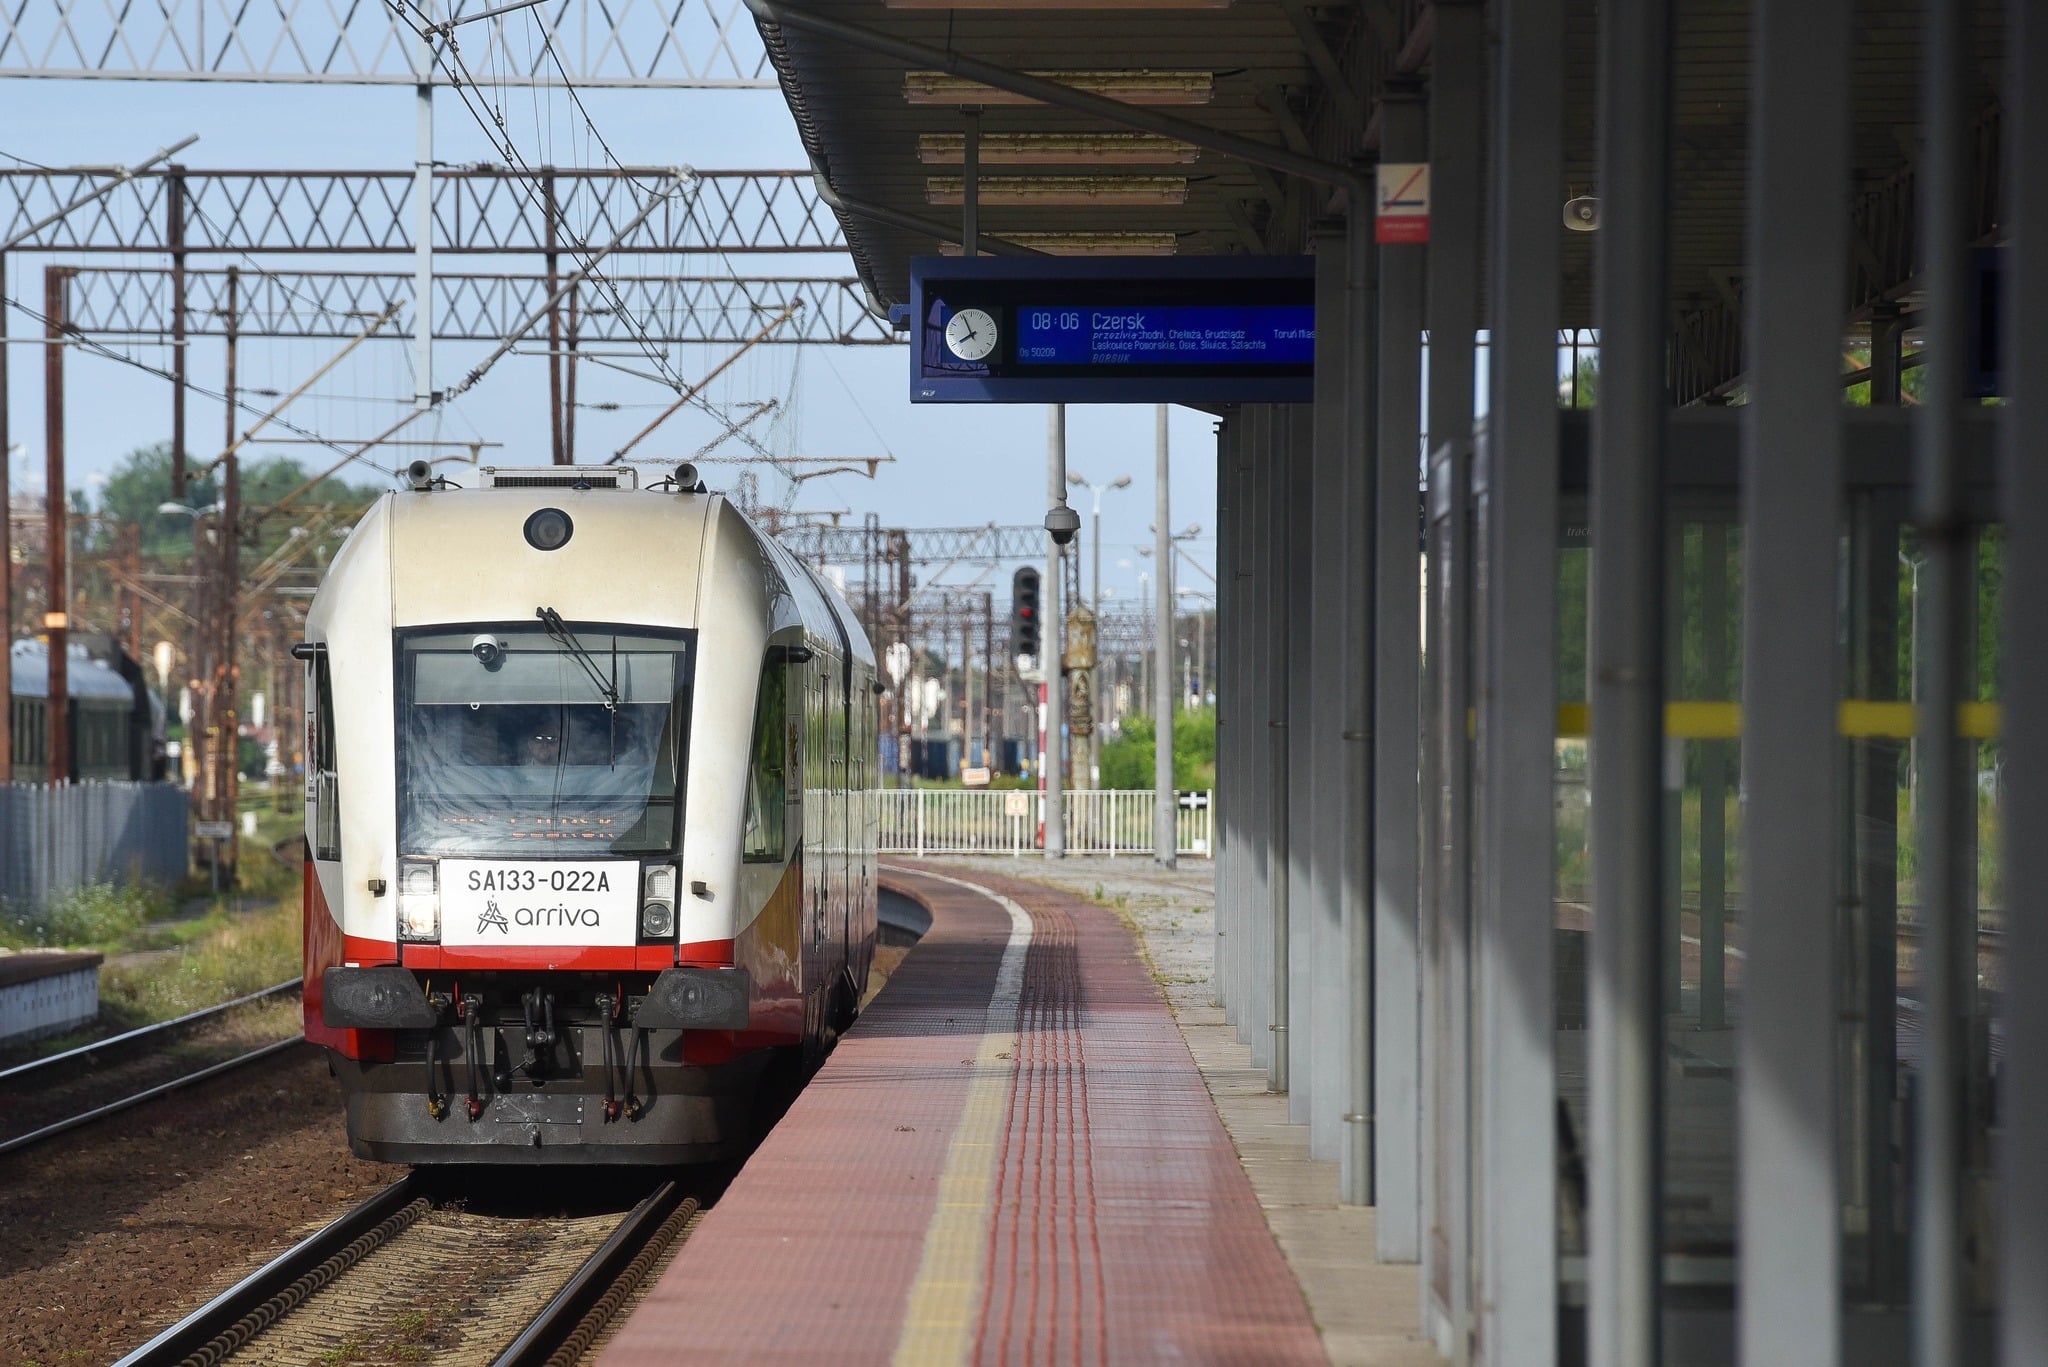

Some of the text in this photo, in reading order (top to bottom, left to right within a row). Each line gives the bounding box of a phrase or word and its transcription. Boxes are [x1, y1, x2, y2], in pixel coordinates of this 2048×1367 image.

[1092, 312, 1145, 330] Czersk
[1031, 347, 1056, 357] 50209
[1092, 340, 1133, 350] Laskowice
[1091, 353, 1131, 364] BORSUK
[468, 870, 610, 892] SA133-022A
[514, 903, 600, 927] arriva
